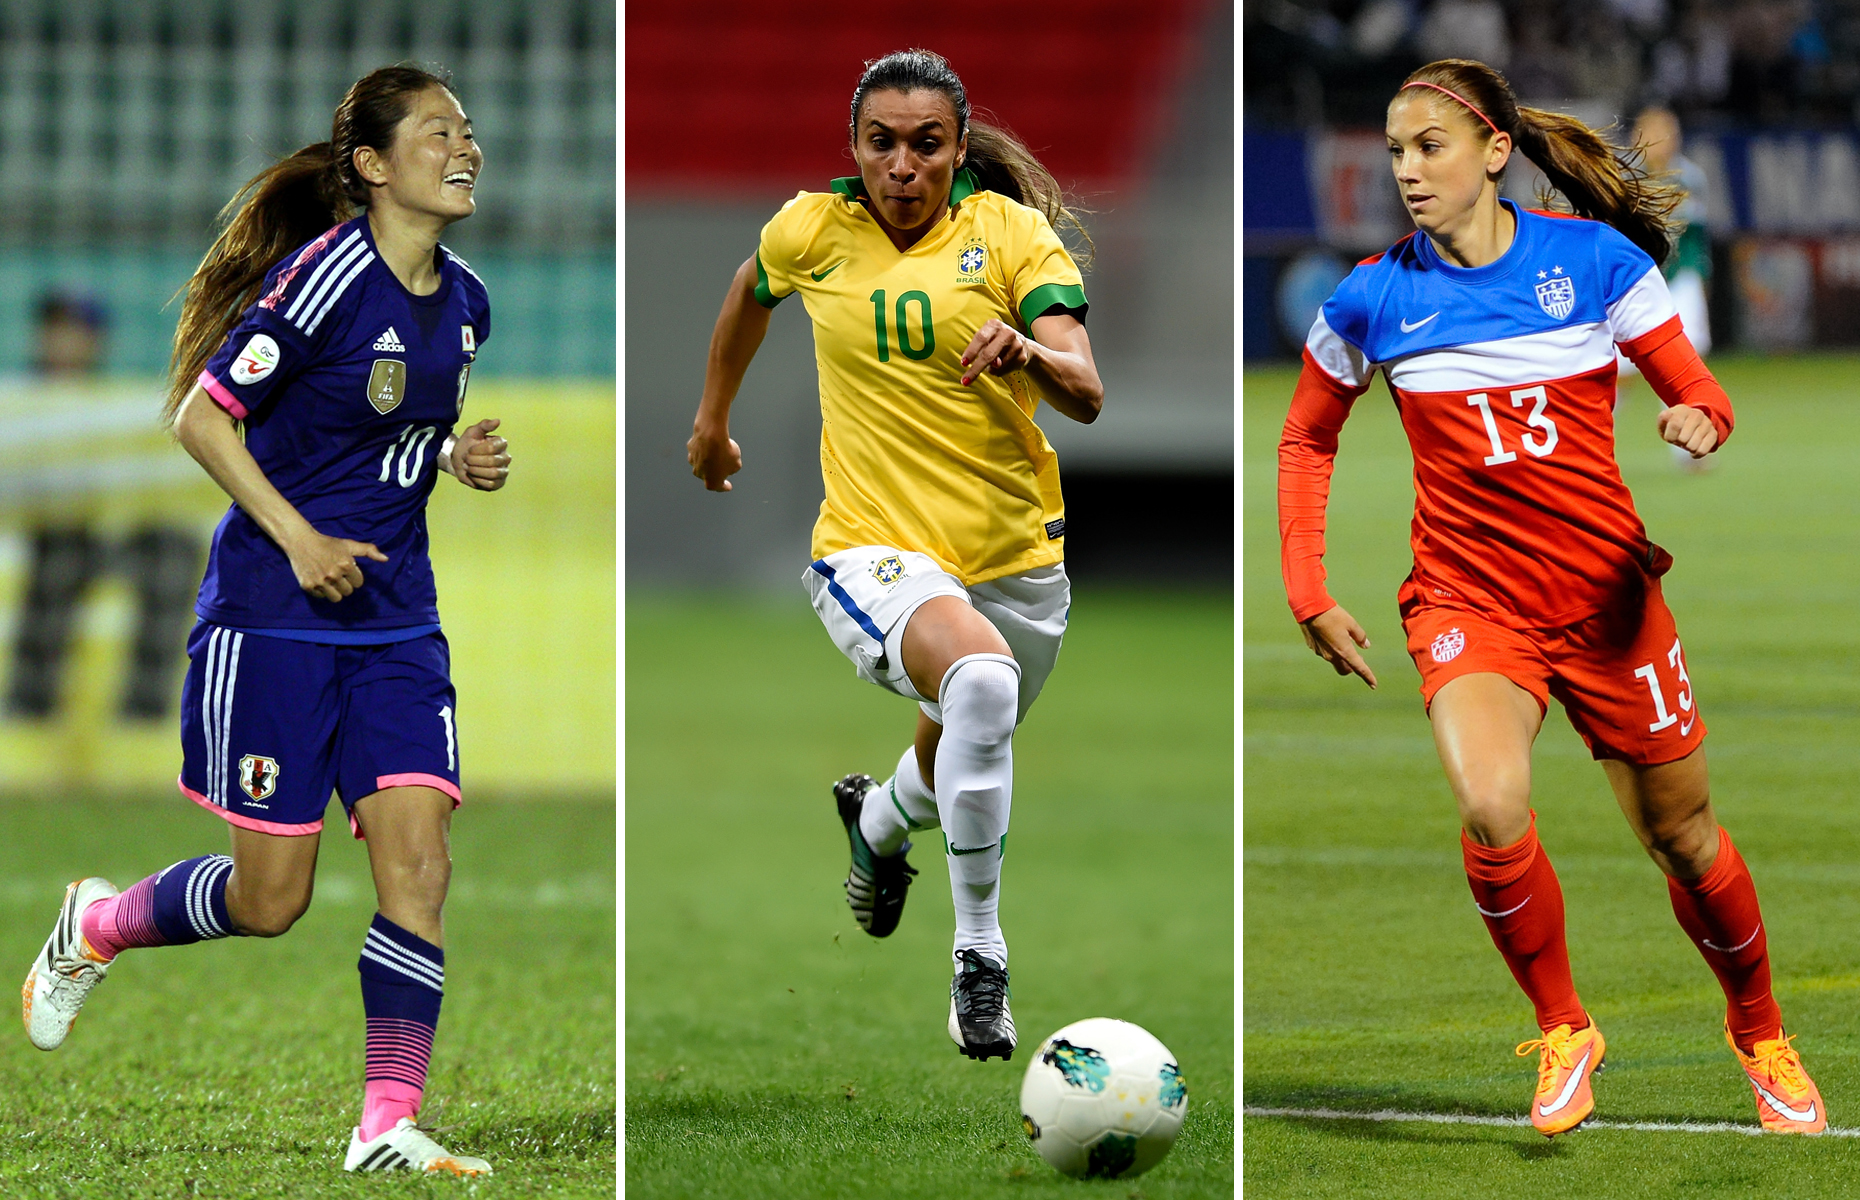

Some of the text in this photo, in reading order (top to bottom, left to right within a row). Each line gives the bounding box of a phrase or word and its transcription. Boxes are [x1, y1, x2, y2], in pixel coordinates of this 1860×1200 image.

[956, 276, 987, 285] BRASIL
[869, 289, 936, 363] 10
[373, 342, 406, 352] adidas
[378, 393, 394, 401] FIFA
[1466, 385, 1559, 466] 13
[377, 423, 437, 489] 10
[1634, 637, 1693, 733] 13
[242, 801, 269, 809] JAPAN
